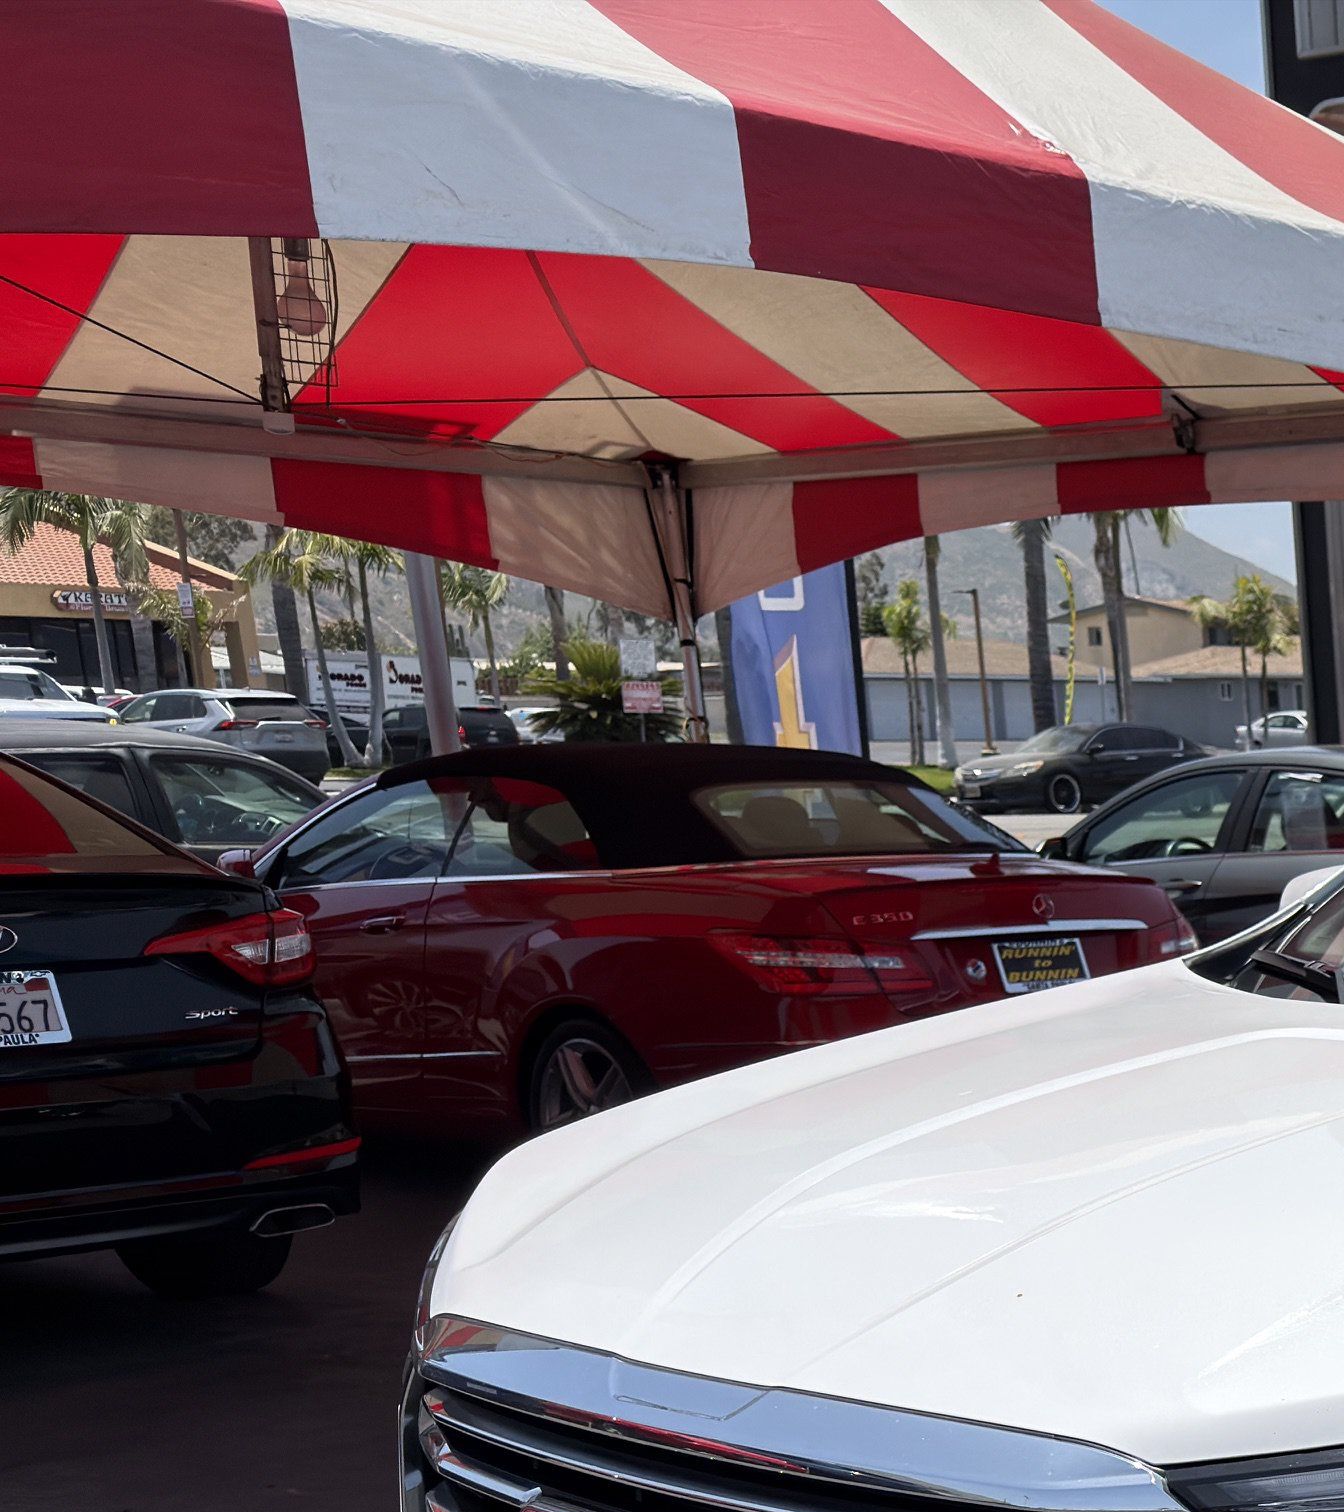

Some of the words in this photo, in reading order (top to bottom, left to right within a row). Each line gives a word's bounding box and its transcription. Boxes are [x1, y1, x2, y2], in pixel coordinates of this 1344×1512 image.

[1034, 959, 1053, 968] to
[1008, 968, 1080, 983] BUNNIN
[185, 1006, 239, 1020] Sport
